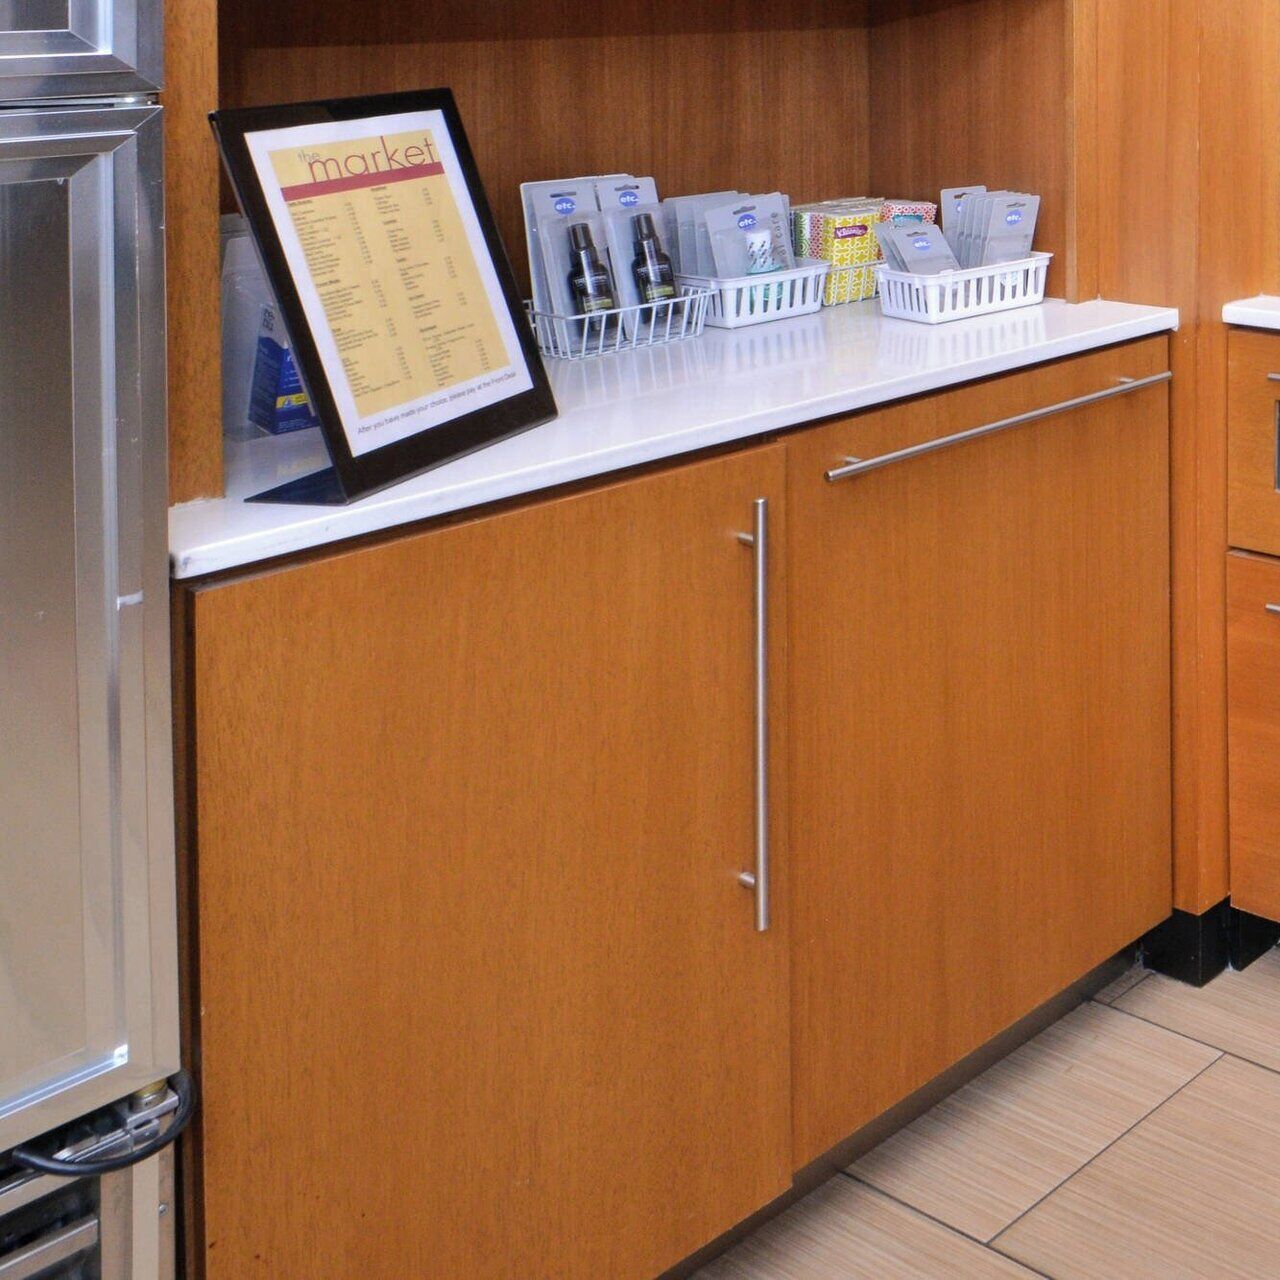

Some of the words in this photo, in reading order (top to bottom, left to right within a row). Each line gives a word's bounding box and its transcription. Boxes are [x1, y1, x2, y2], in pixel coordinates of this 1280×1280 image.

[298, 149, 321, 167] the
[308, 135, 438, 184] market
[555, 200, 577, 212] etc.
[620, 194, 641, 206] etc.
